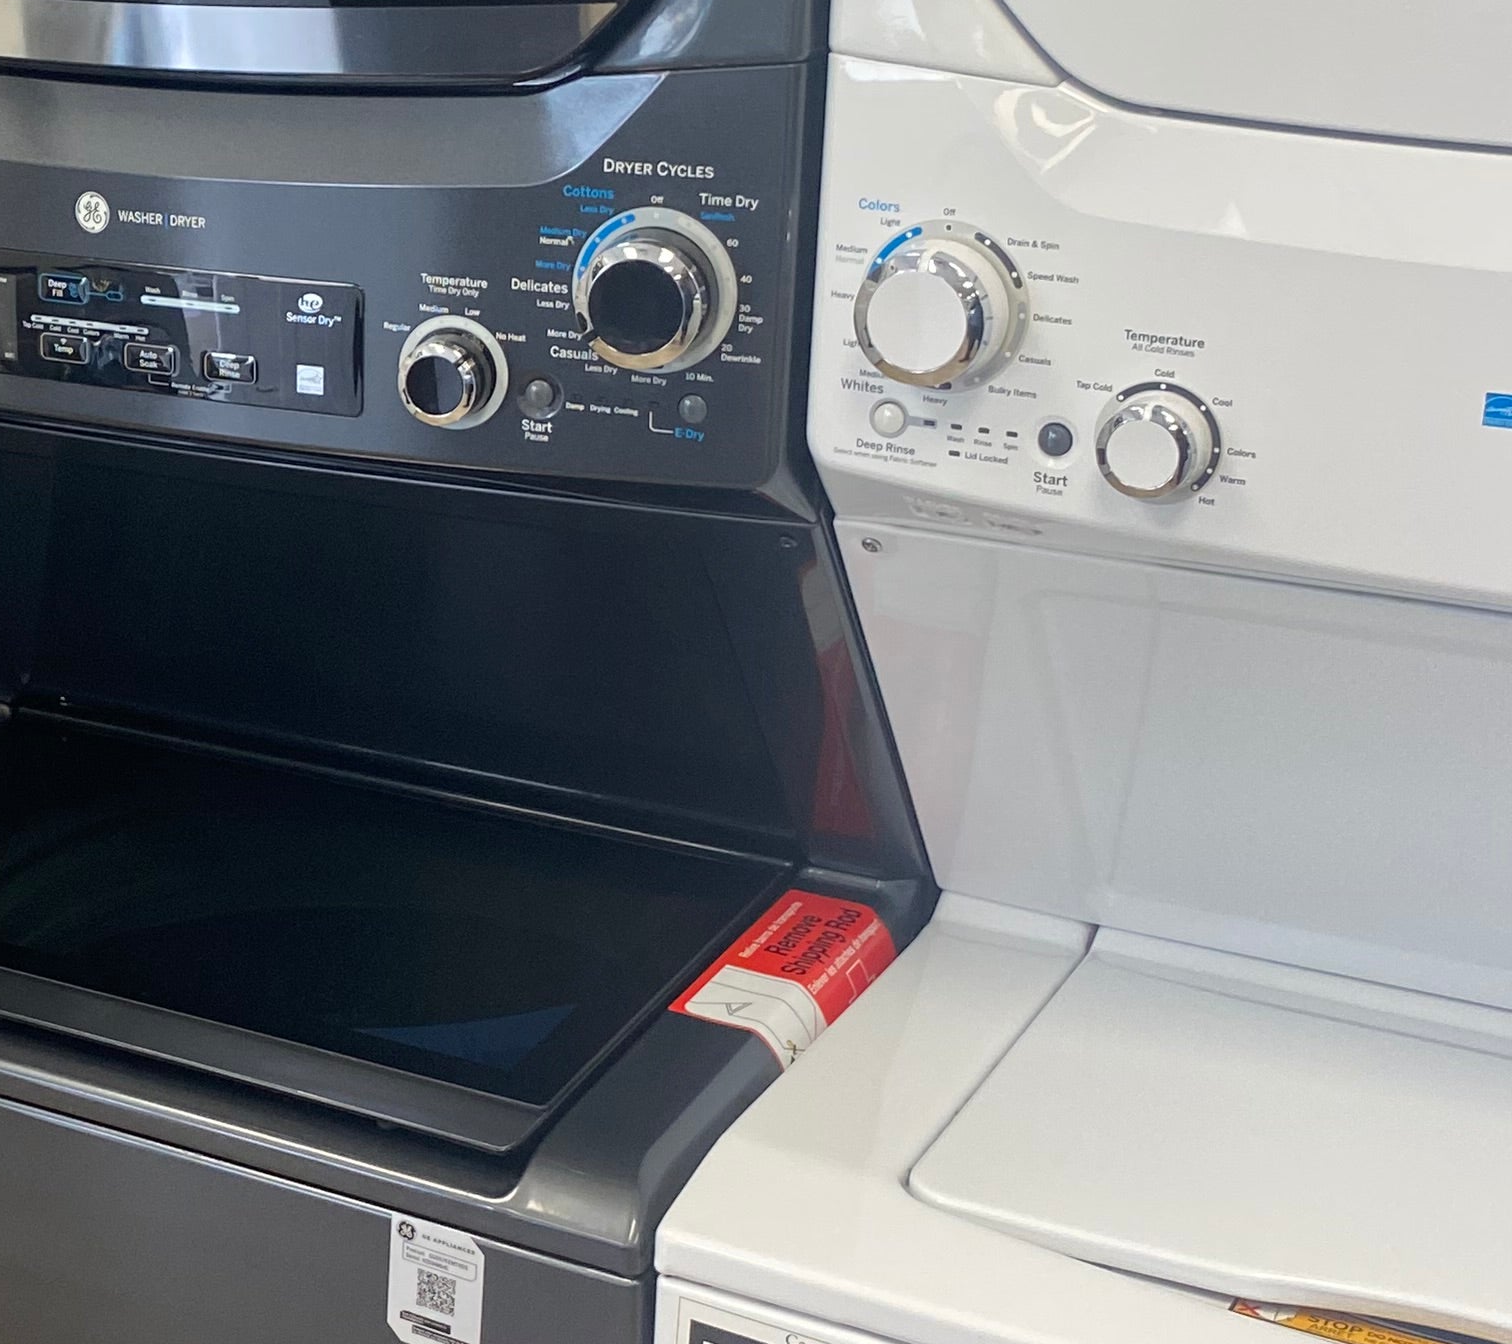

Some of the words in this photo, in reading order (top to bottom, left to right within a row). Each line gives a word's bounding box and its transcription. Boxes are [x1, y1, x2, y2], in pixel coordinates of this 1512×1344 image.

[603, 158, 653, 177] DRYER
[656, 161, 715, 180] CYCLES
[562, 184, 615, 200] Cottons
[650, 194, 665, 204] Off
[699, 192, 733, 207] Time
[735, 195, 760, 211] Dry
[858, 197, 901, 213] Colors
[599, 206, 616, 216] Dry
[943, 207, 956, 217] Off
[117, 210, 163, 225] WASHER
[169, 214, 206, 229] DRYER
[880, 217, 901, 228] Light
[539, 236, 568, 246] Normal
[727, 238, 739, 248] 60
[1007, 238, 1030, 248] Drain
[1040, 241, 1060, 251] Spin
[836, 243, 868, 254] Medium
[556, 261, 572, 271] Dry
[420, 273, 488, 290] Temperature
[740, 274, 752, 284] 40
[1027, 271, 1055, 283] Speed
[1056, 273, 1079, 284] Wash
[48, 279, 67, 289] Deep
[511, 278, 568, 295] Delicates
[428, 284, 447, 295] Time
[448, 286, 461, 297] Dry
[462, 287, 480, 298] Only
[831, 290, 855, 302] Heavy
[419, 303, 449, 314] Medium
[537, 299, 554, 309] Less
[555, 300, 570, 311] Dry
[739, 304, 751, 313] 30
[286, 312, 316, 324] Sensor
[465, 307, 481, 317] Low
[738, 314, 764, 325] Damp
[1033, 313, 1073, 326] Delicates
[547, 329, 566, 339] More
[567, 330, 583, 341] Dry
[738, 324, 754, 335] Dry
[496, 332, 507, 341] No
[507, 333, 526, 343] Heat
[1124, 329, 1205, 350] Temperature
[550, 345, 599, 361] Casuals
[721, 343, 733, 353] 20
[1131, 343, 1143, 352] All
[1145, 344, 1165, 355] Cold
[1018, 354, 1052, 366] Casuals
[585, 364, 602, 373] Less
[603, 365, 618, 376] Dry
[1154, 368, 1175, 379] Cold
[631, 375, 650, 385] More
[651, 376, 667, 387] Dry
[685, 372, 695, 382] 10
[841, 378, 884, 394] Whites
[988, 385, 1012, 397] Bulky
[1013, 389, 1037, 399] Items
[1076, 380, 1092, 392] Tap
[1093, 382, 1113, 393] Cold
[922, 394, 948, 406] Heavy
[1212, 397, 1233, 408] Cool
[590, 403, 611, 415] Drying
[521, 418, 553, 434] Start
[524, 432, 550, 443] Pause
[674, 427, 706, 443] E-Dry
[856, 438, 883, 452] Deep
[885, 442, 916, 456] Rinse
[1226, 447, 1256, 459] Colors
[964, 451, 977, 461] Lid
[979, 453, 1009, 465] Locked
[1033, 472, 1068, 487] Start
[1219, 474, 1246, 485] Warm
[1036, 485, 1063, 496] Pause
[1198, 496, 1215, 506] Hot
[764, 915, 823, 956] Remove
[781, 930, 846, 976] Shipping
[825, 907, 863, 932] Rod
[1307, 1315, 1364, 1333] STOP
